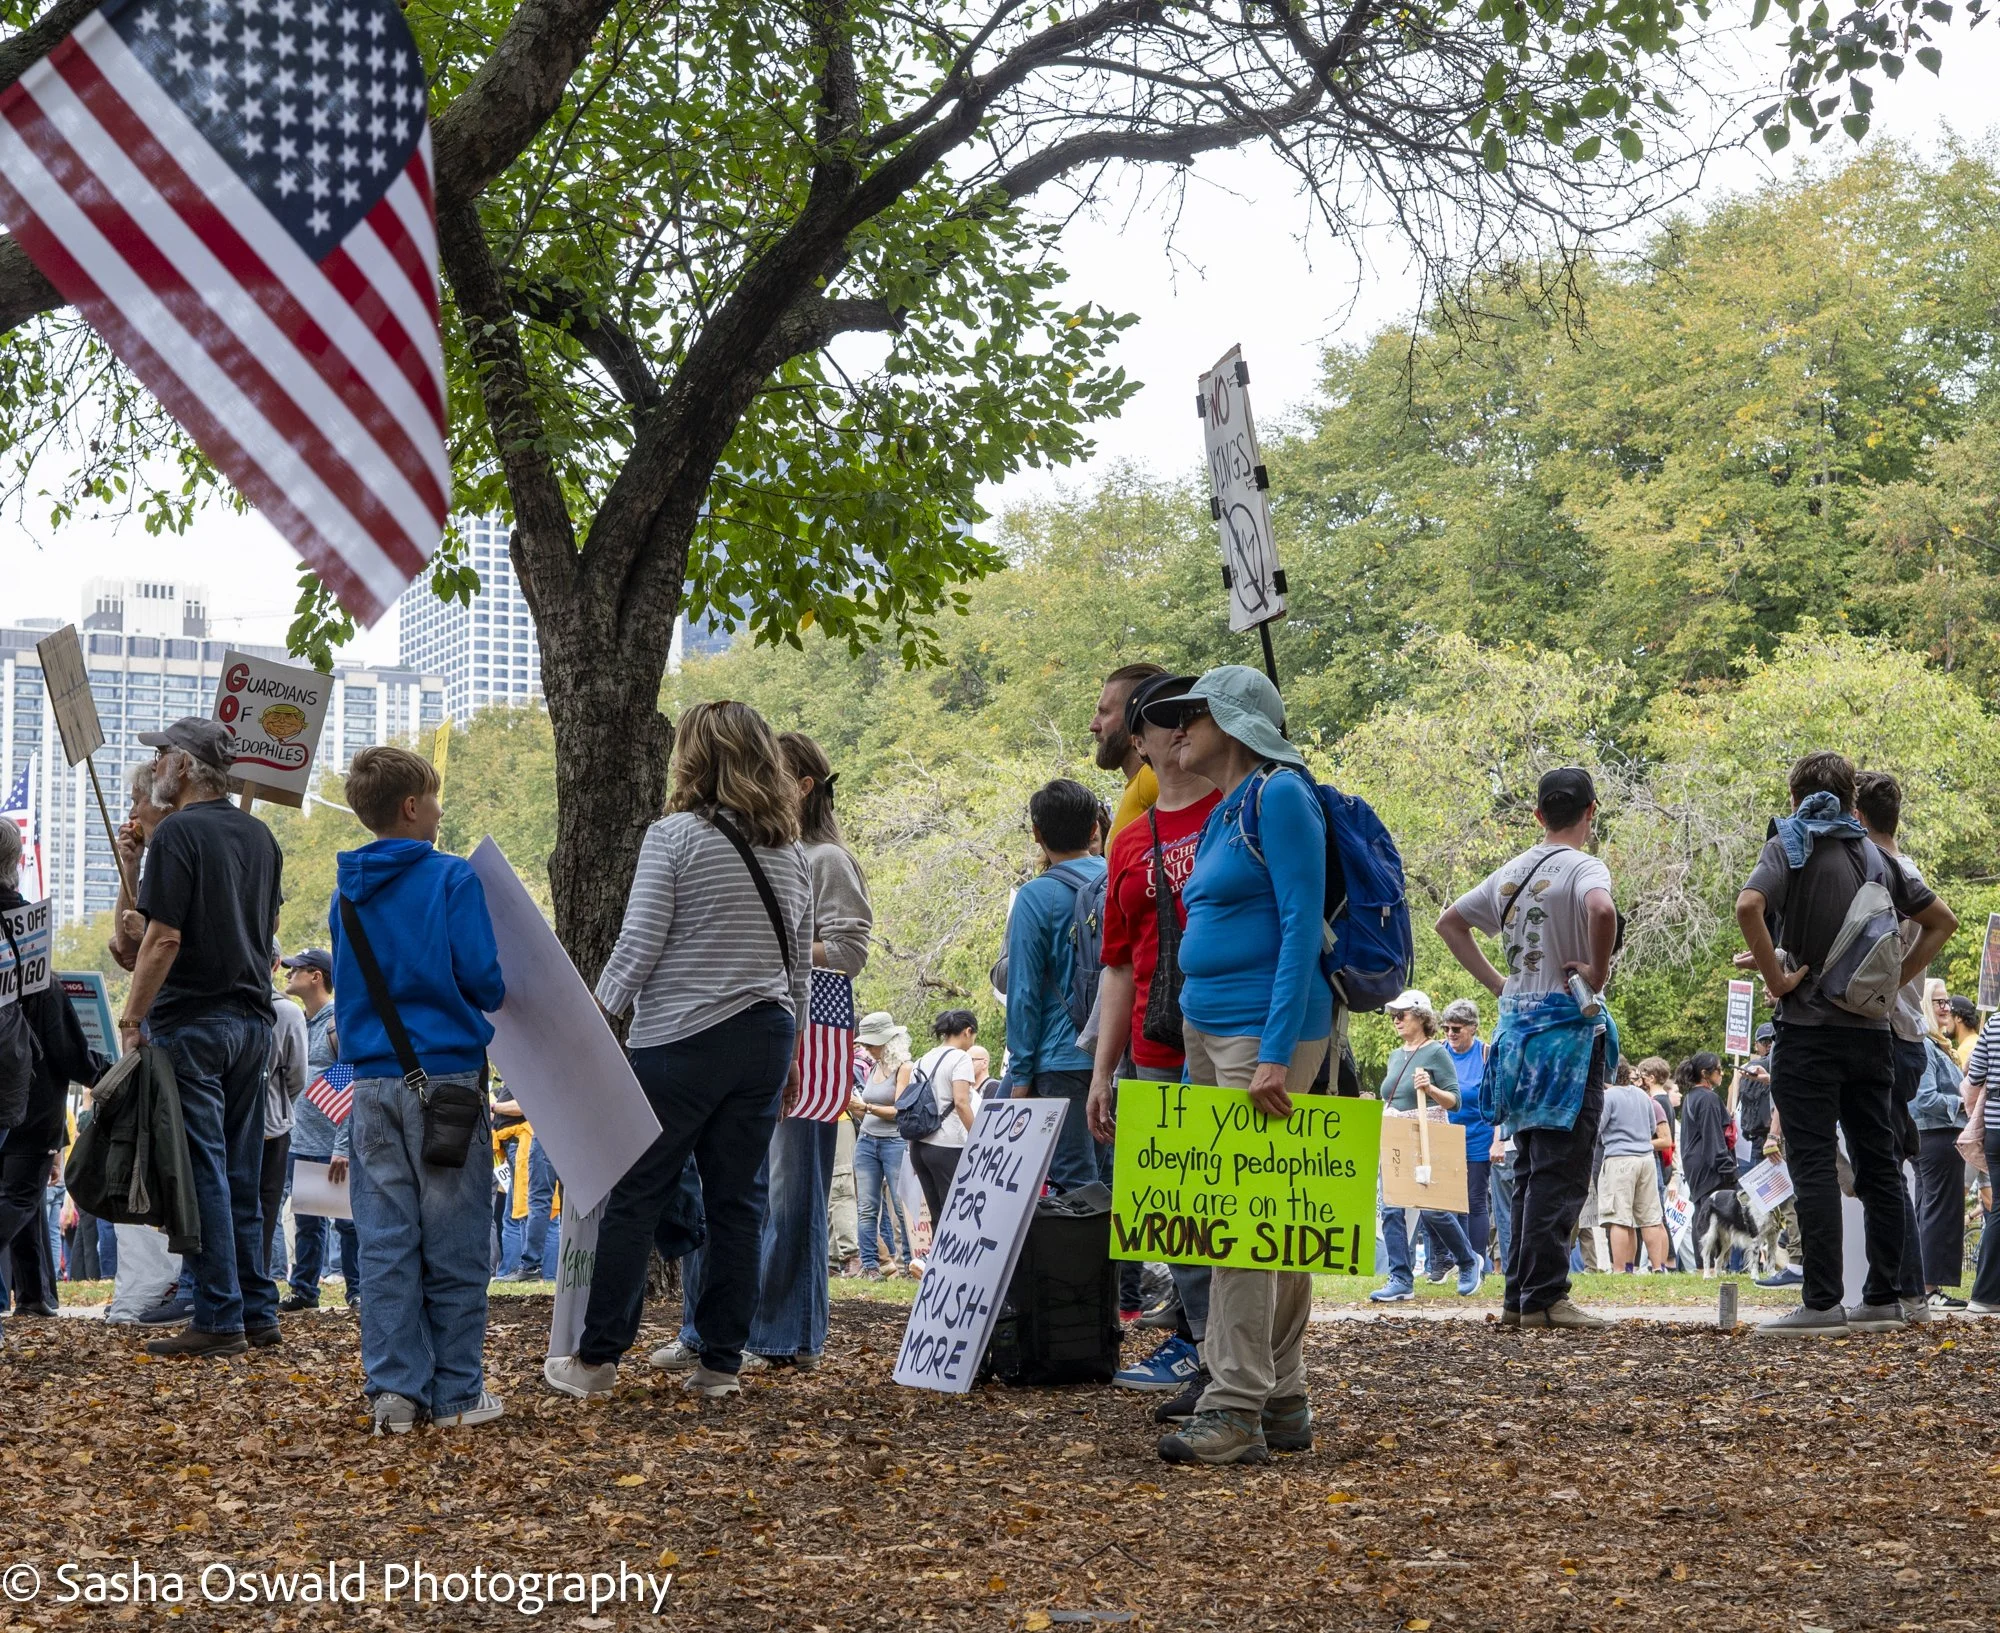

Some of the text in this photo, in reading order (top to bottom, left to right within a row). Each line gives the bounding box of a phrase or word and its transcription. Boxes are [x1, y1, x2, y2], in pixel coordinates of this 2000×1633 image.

[1210, 375, 1230, 431] NO
[1209, 432, 1252, 495] KINGS
[226, 663, 318, 706] GUARDIANS
[218, 695, 254, 724] OF
[225, 725, 304, 762] EDOPHILES
[27, 905, 47, 932] OFF
[978, 1102, 1033, 1143] TOO
[1156, 1085, 1341, 1151] If you are
[957, 1143, 1024, 1193] SMALL
[1137, 1136, 1357, 1187] obeying pedophiles
[945, 1187, 987, 1230] FOR
[1131, 1185, 1336, 1224] you are on the
[1665, 1205, 1687, 1227] KINGS
[1675, 1199, 1687, 1213] NO
[931, 1229, 998, 1268] MOUNT
[1113, 1211, 1361, 1276] WRONG SIDE!
[914, 1267, 989, 1330] RUSH-
[899, 1329, 968, 1381] MORE
